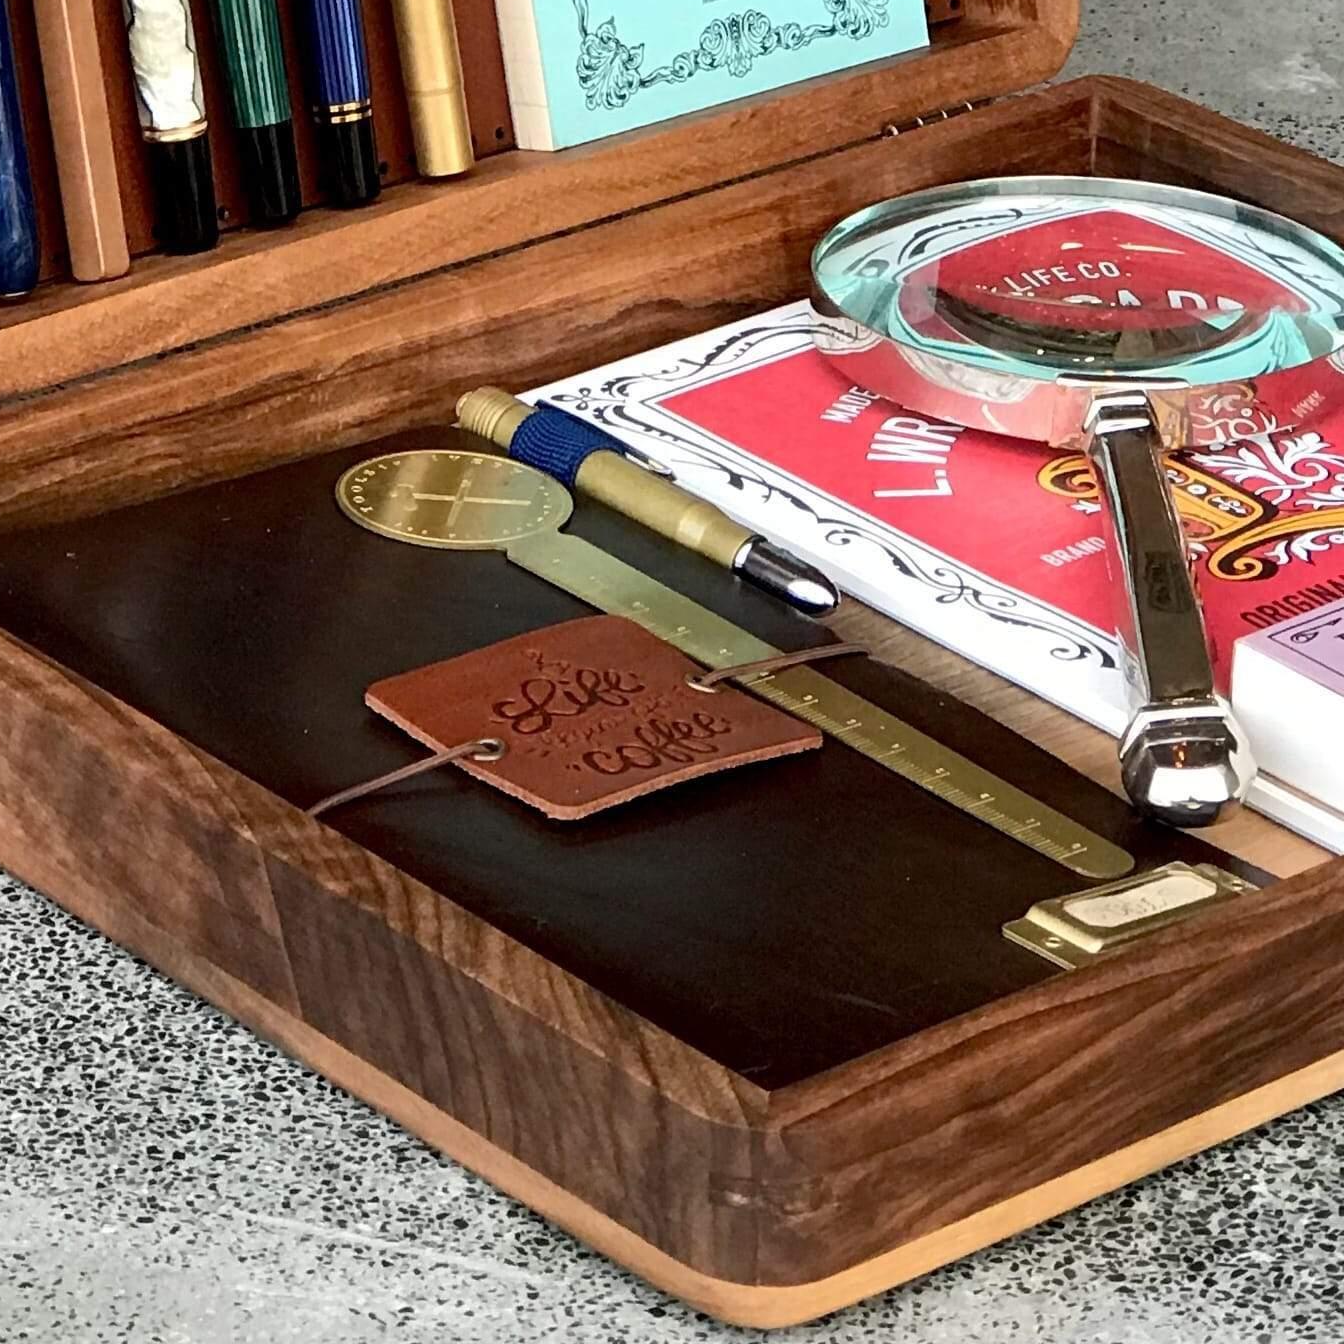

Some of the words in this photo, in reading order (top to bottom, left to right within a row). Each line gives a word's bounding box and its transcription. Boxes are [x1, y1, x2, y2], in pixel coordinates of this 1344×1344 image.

[1003, 264, 1077, 294] LIFE
[820, 385, 880, 424] MADE
[1039, 536, 1106, 568] BRAND
